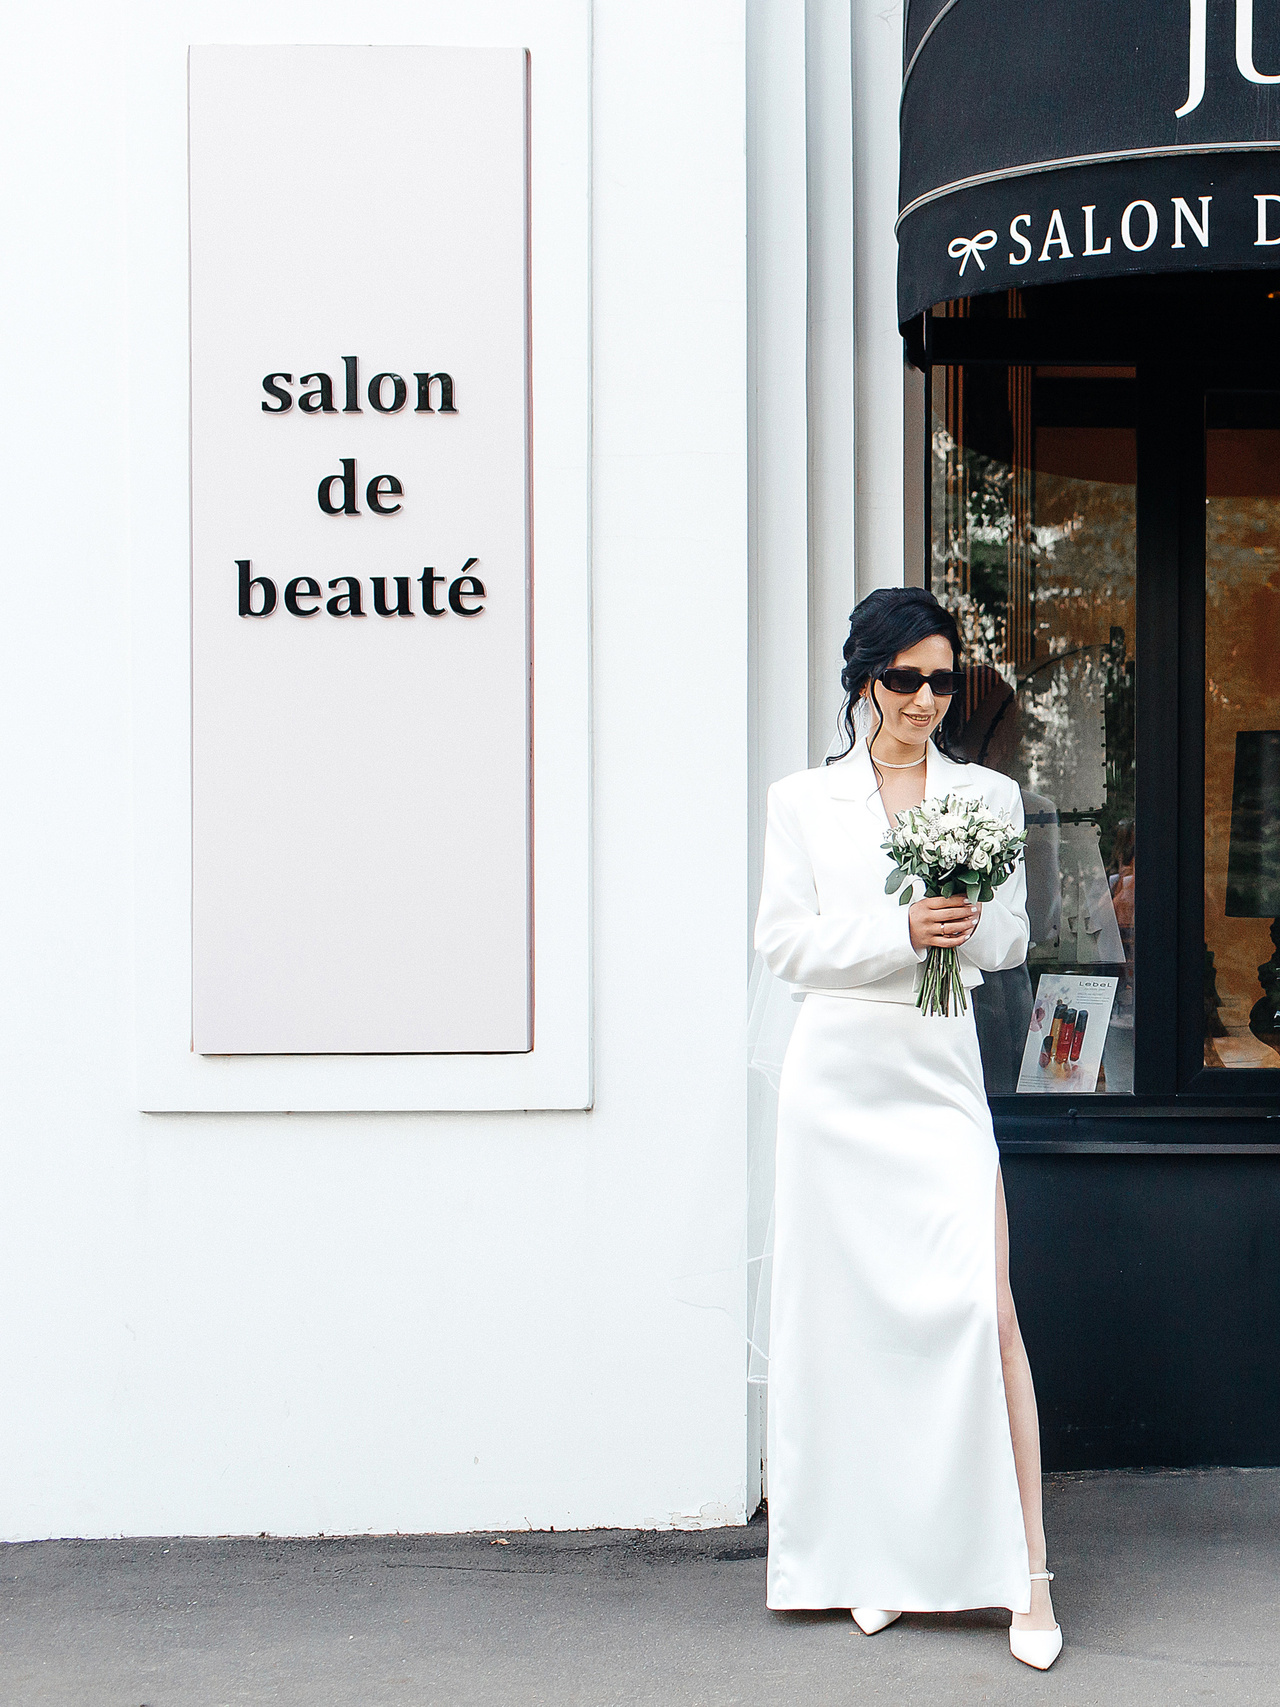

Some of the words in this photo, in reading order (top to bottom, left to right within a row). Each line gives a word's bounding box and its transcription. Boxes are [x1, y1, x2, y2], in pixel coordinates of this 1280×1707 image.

[1009, 195, 1214, 266] SALON
[261, 355, 459, 415] salon
[317, 458, 404, 516] de
[234, 557, 487, 619] beauté
